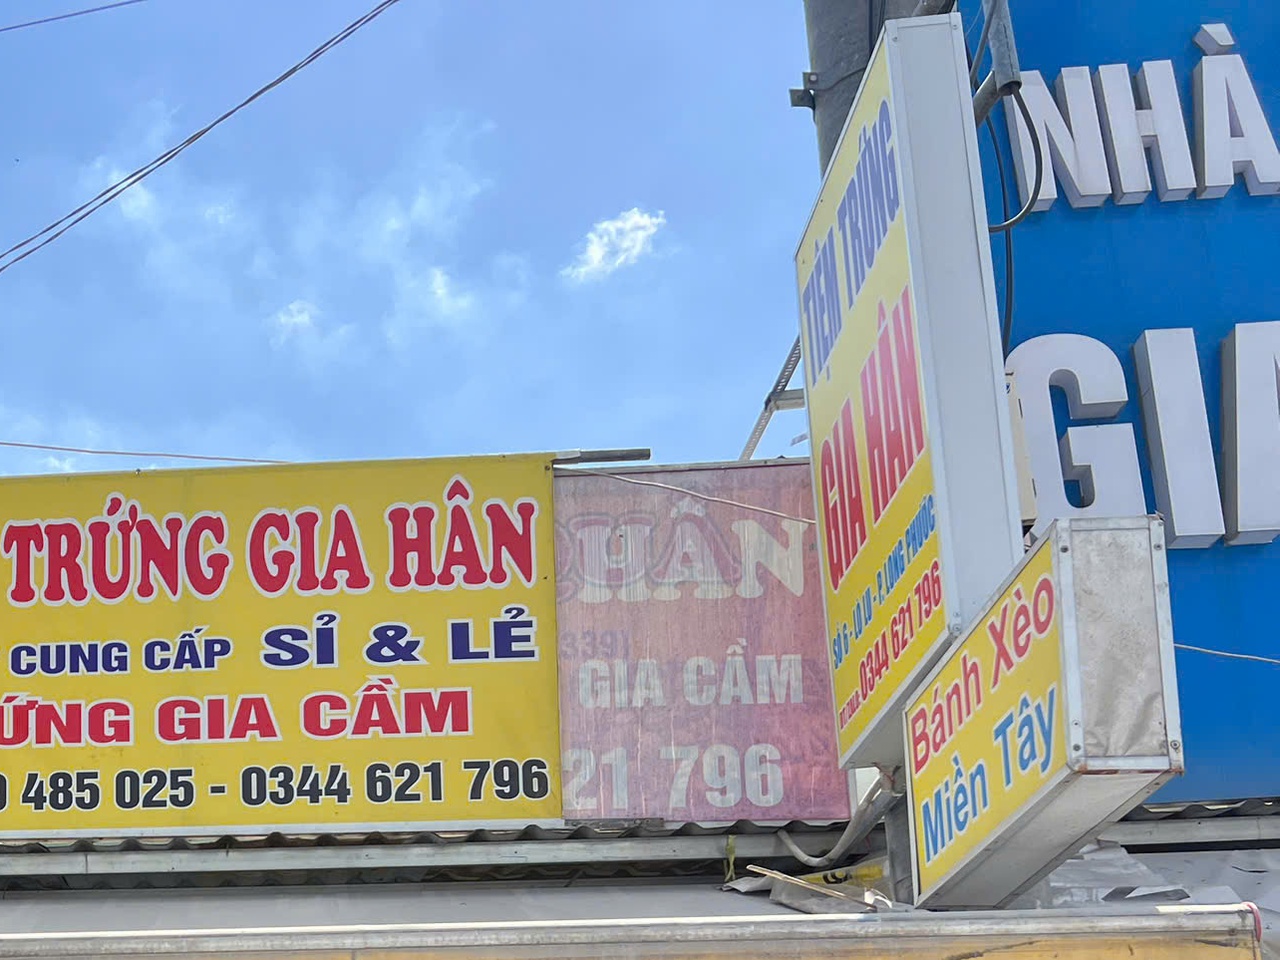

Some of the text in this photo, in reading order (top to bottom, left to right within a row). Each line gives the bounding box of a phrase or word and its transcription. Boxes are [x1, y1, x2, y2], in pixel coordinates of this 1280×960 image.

[1003, 22, 1280, 212] NHÀ
[801, 99, 900, 388] TIỆM TRỨNG
[819, 283, 926, 593] GIA HÂN
[1, 492, 232, 608] TRỨNG
[246, 504, 372, 597] GIA
[385, 474, 537, 591] HÂN
[9, 641, 129, 676] CUNG
[143, 626, 232, 672] CẤP
[365, 621, 426, 665] &
[447, 604, 539, 664] LẺ
[578, 659, 666, 708] GIA
[682, 637, 803, 705] CẦM
[859, 560, 941, 701] 0344 621 796
[910, 576, 1056, 776] Bánh Xèo
[154, 695, 281, 743] GIA
[300, 675, 472, 741] CẦM
[659, 743, 784, 809] 796
[921, 687, 1056, 864] Miền Tây
[21, 770, 100, 811] 485
[114, 768, 195, 809] 025
[240, 764, 351, 807] 0344
[365, 760, 444, 803] 621
[462, 757, 549, 801] 796
